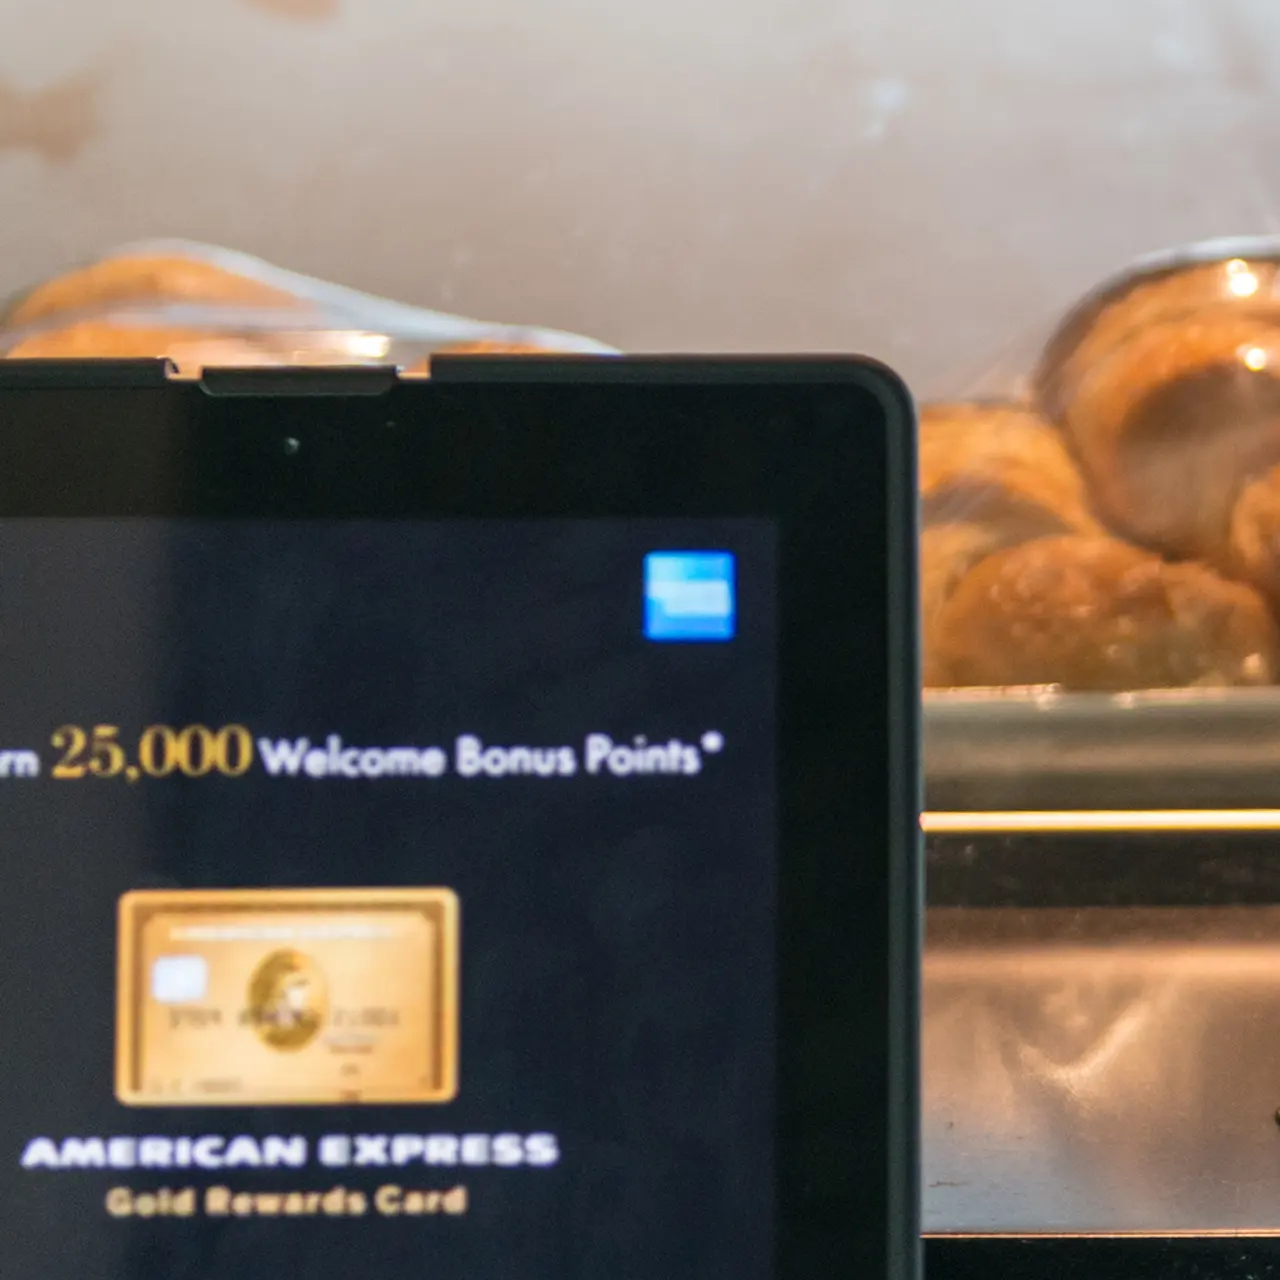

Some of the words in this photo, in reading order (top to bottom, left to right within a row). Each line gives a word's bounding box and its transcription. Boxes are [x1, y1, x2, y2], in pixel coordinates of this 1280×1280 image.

[52, 724, 253, 782] 25,000
[257, 734, 447, 778] Welcome
[455, 734, 577, 777] Bonus
[20, 1135, 307, 1169] AMERICAN
[318, 1132, 559, 1167] EXPRESS
[106, 1187, 195, 1216] Gold
[206, 1187, 366, 1215] Rewards
[375, 1186, 466, 1214] Card
